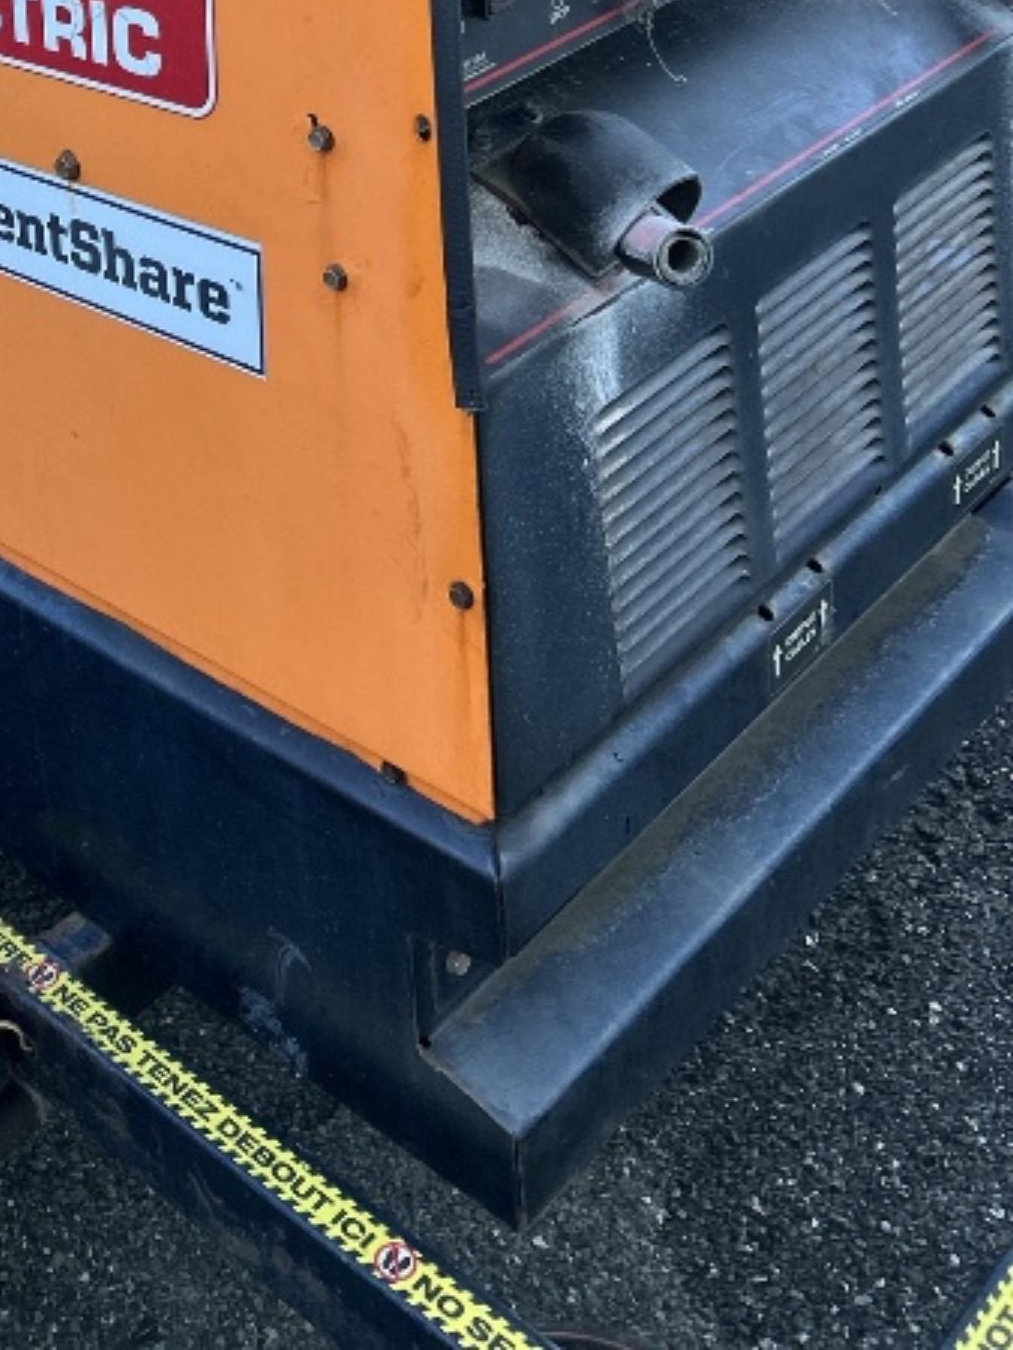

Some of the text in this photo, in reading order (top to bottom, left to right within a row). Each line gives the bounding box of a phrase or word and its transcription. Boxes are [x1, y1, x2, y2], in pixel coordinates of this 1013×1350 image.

[52, 983, 90, 1019] NE
[87, 1011, 138, 1055] PAS
[136, 1048, 221, 1122] TENEZ
[215, 1116, 336, 1218] DEBOUT
[332, 1211, 376, 1251] ICI
[411, 1274, 466, 1320] NO
